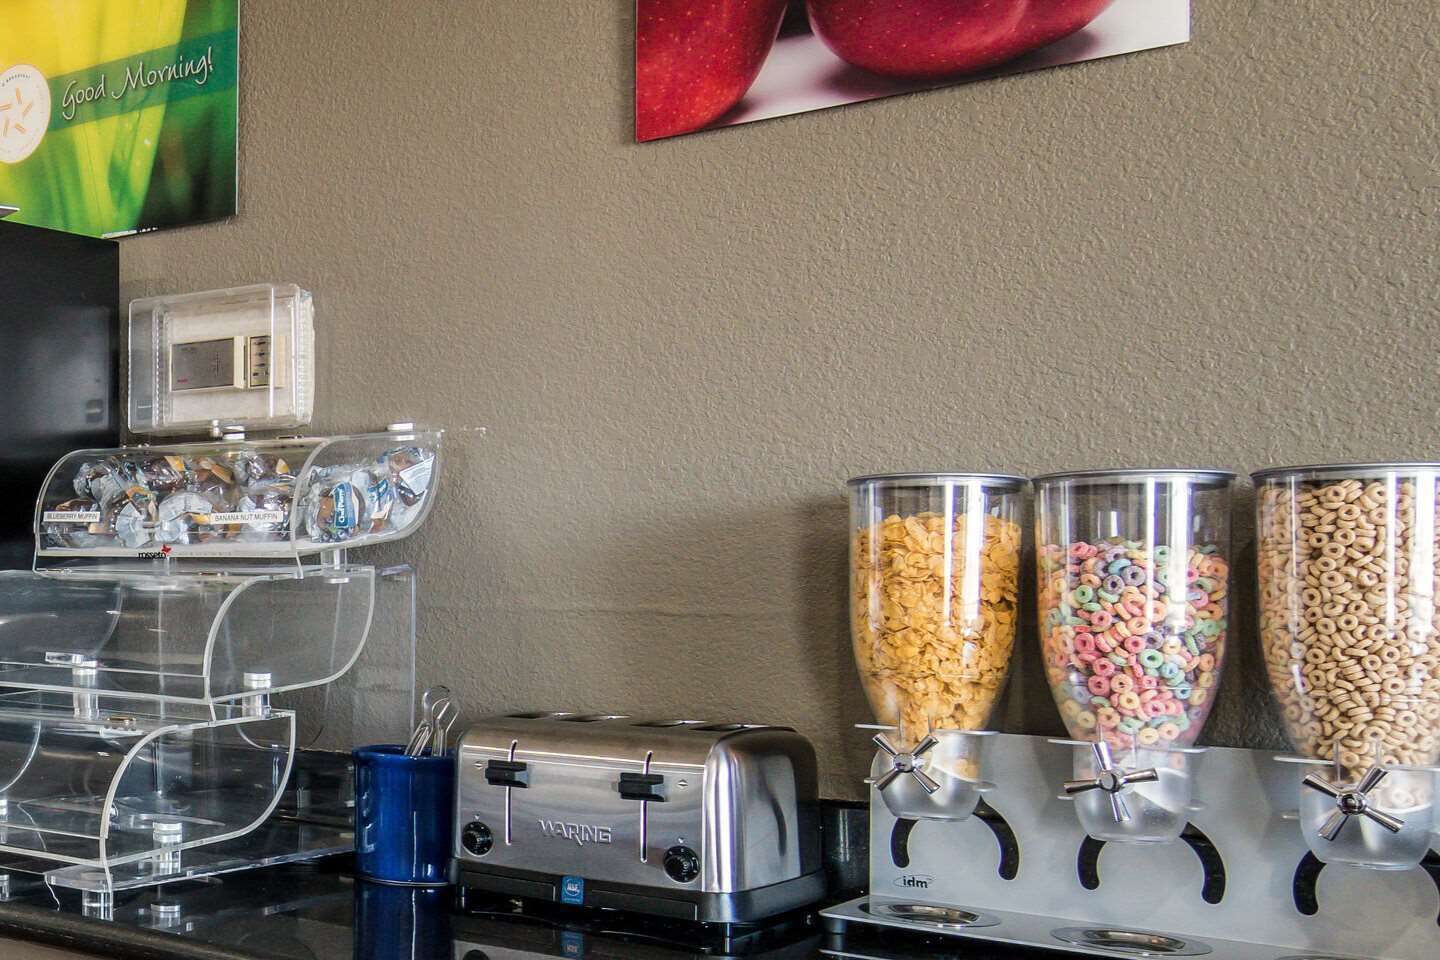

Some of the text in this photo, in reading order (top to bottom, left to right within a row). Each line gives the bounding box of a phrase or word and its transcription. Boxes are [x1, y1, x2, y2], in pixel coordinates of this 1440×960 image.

[62, 46, 214, 120] Good Morning!
[215, 512, 278, 521] BANANA NUT MUFFIN
[539, 819, 612, 846] WARING
[903, 875, 928, 889] idm
